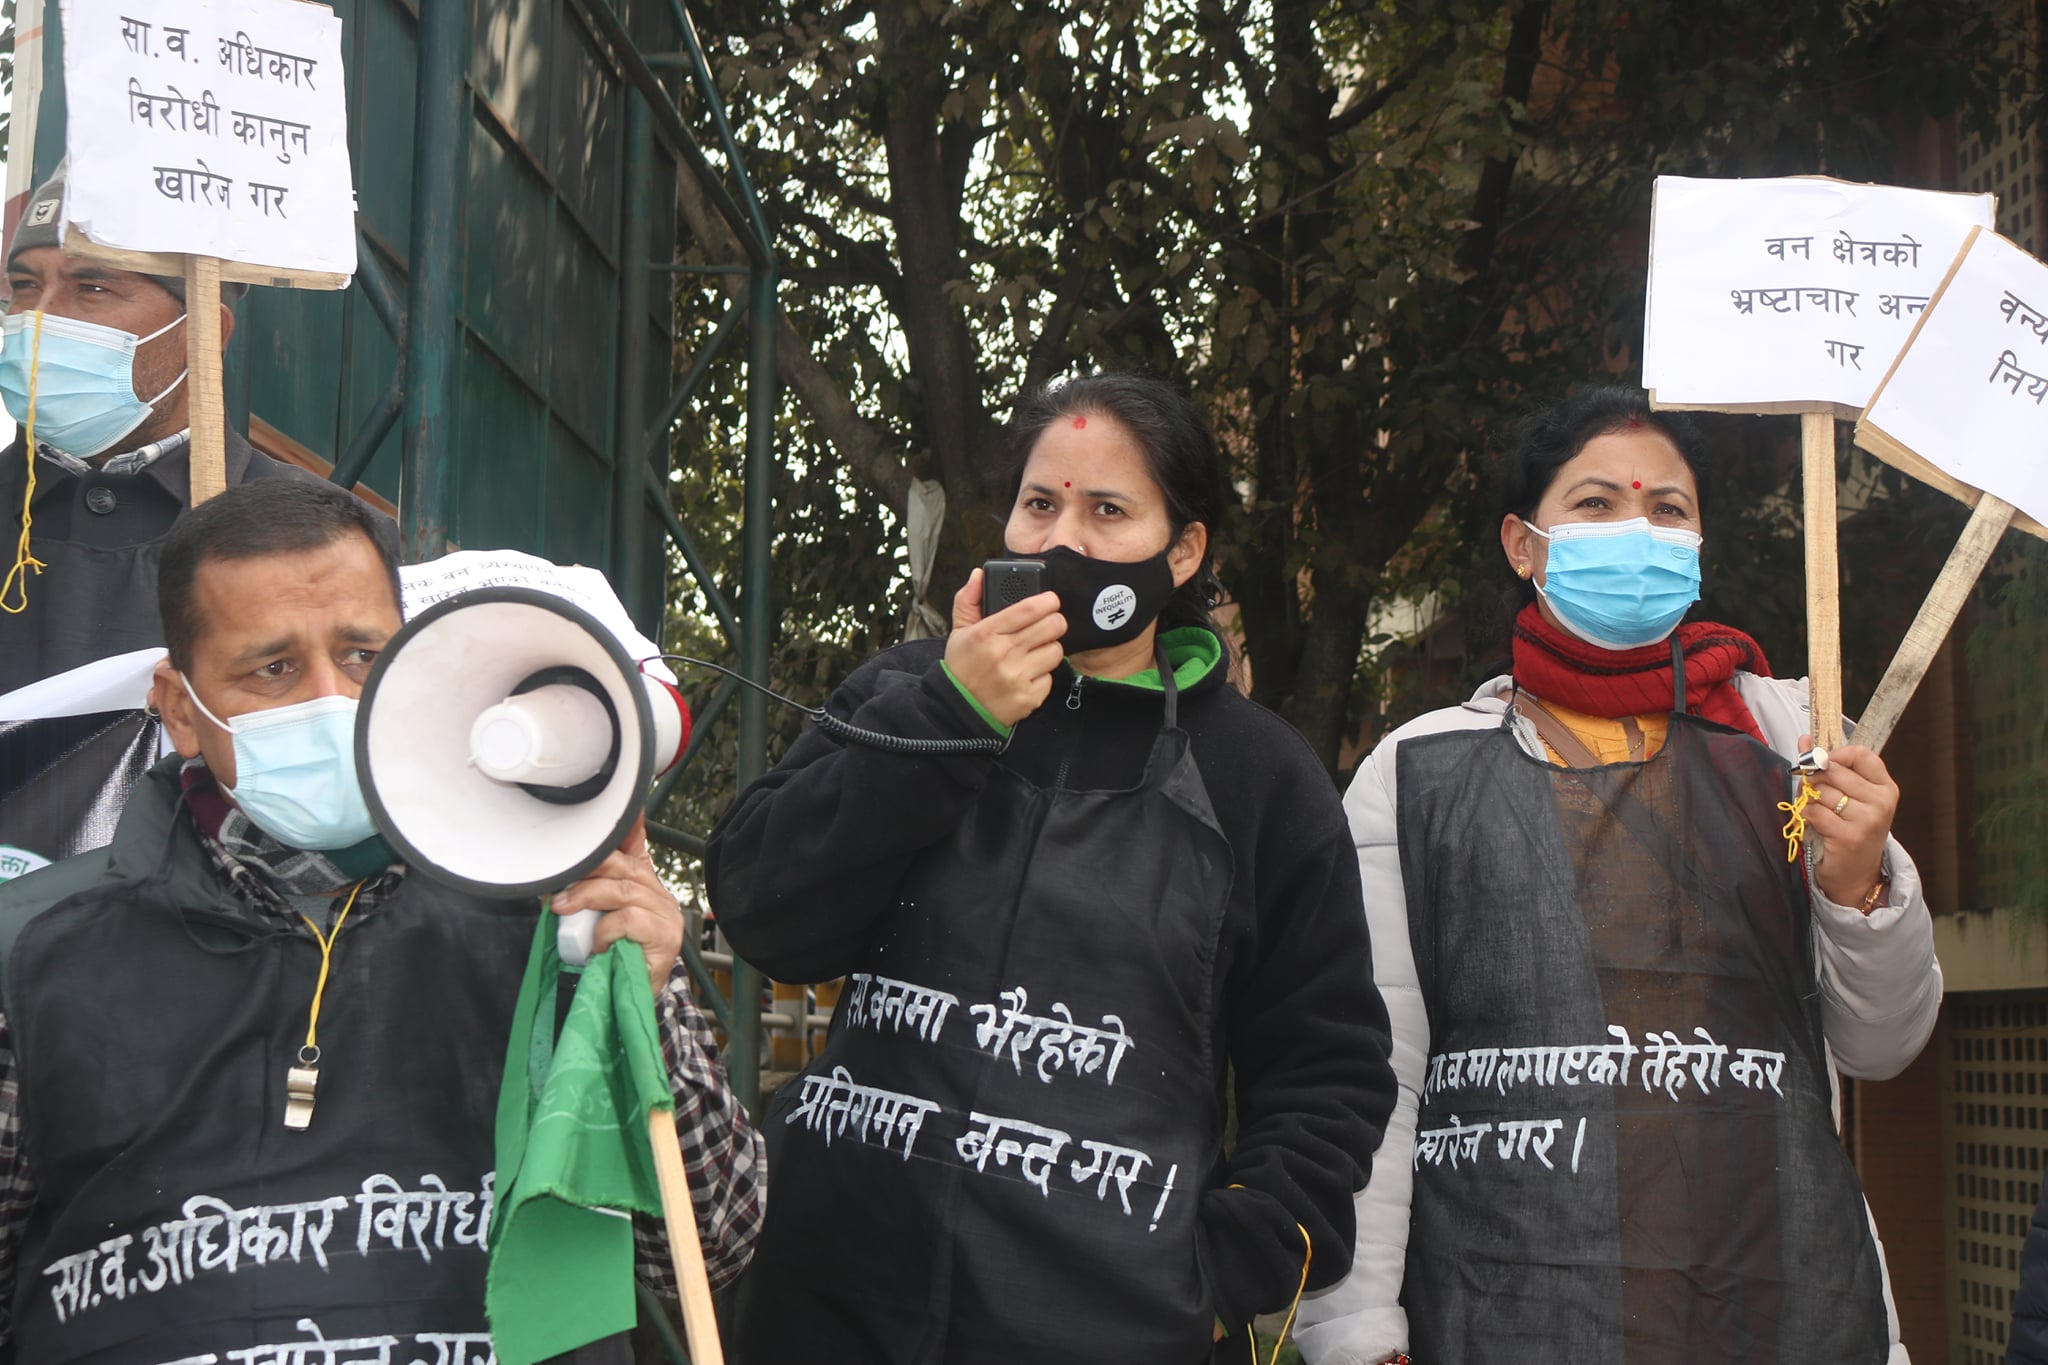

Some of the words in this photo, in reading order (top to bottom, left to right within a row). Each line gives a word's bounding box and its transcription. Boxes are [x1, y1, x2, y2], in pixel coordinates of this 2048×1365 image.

[217, 30, 318, 91] अधिकार
[128, 76, 221, 137] विरोधी
[231, 110, 311, 165] कानुन
[153, 158, 233, 210] खारेज
[248, 181, 288, 219] गर
[1765, 235, 1814, 262] वन
[1832, 230, 1922, 269] क्षेत्रको
[1730, 286, 1860, 319] भ्रष्टाचार
[1824, 339, 1864, 371] गर
[1095, 594, 1133, 615] INEQUALITY
[1103, 590, 1124, 604] FIGHT
[969, 986, 1135, 1086] भैरहेको
[1728, 1047, 1787, 1099] कर
[955, 1110, 1072, 1199] बन्द
